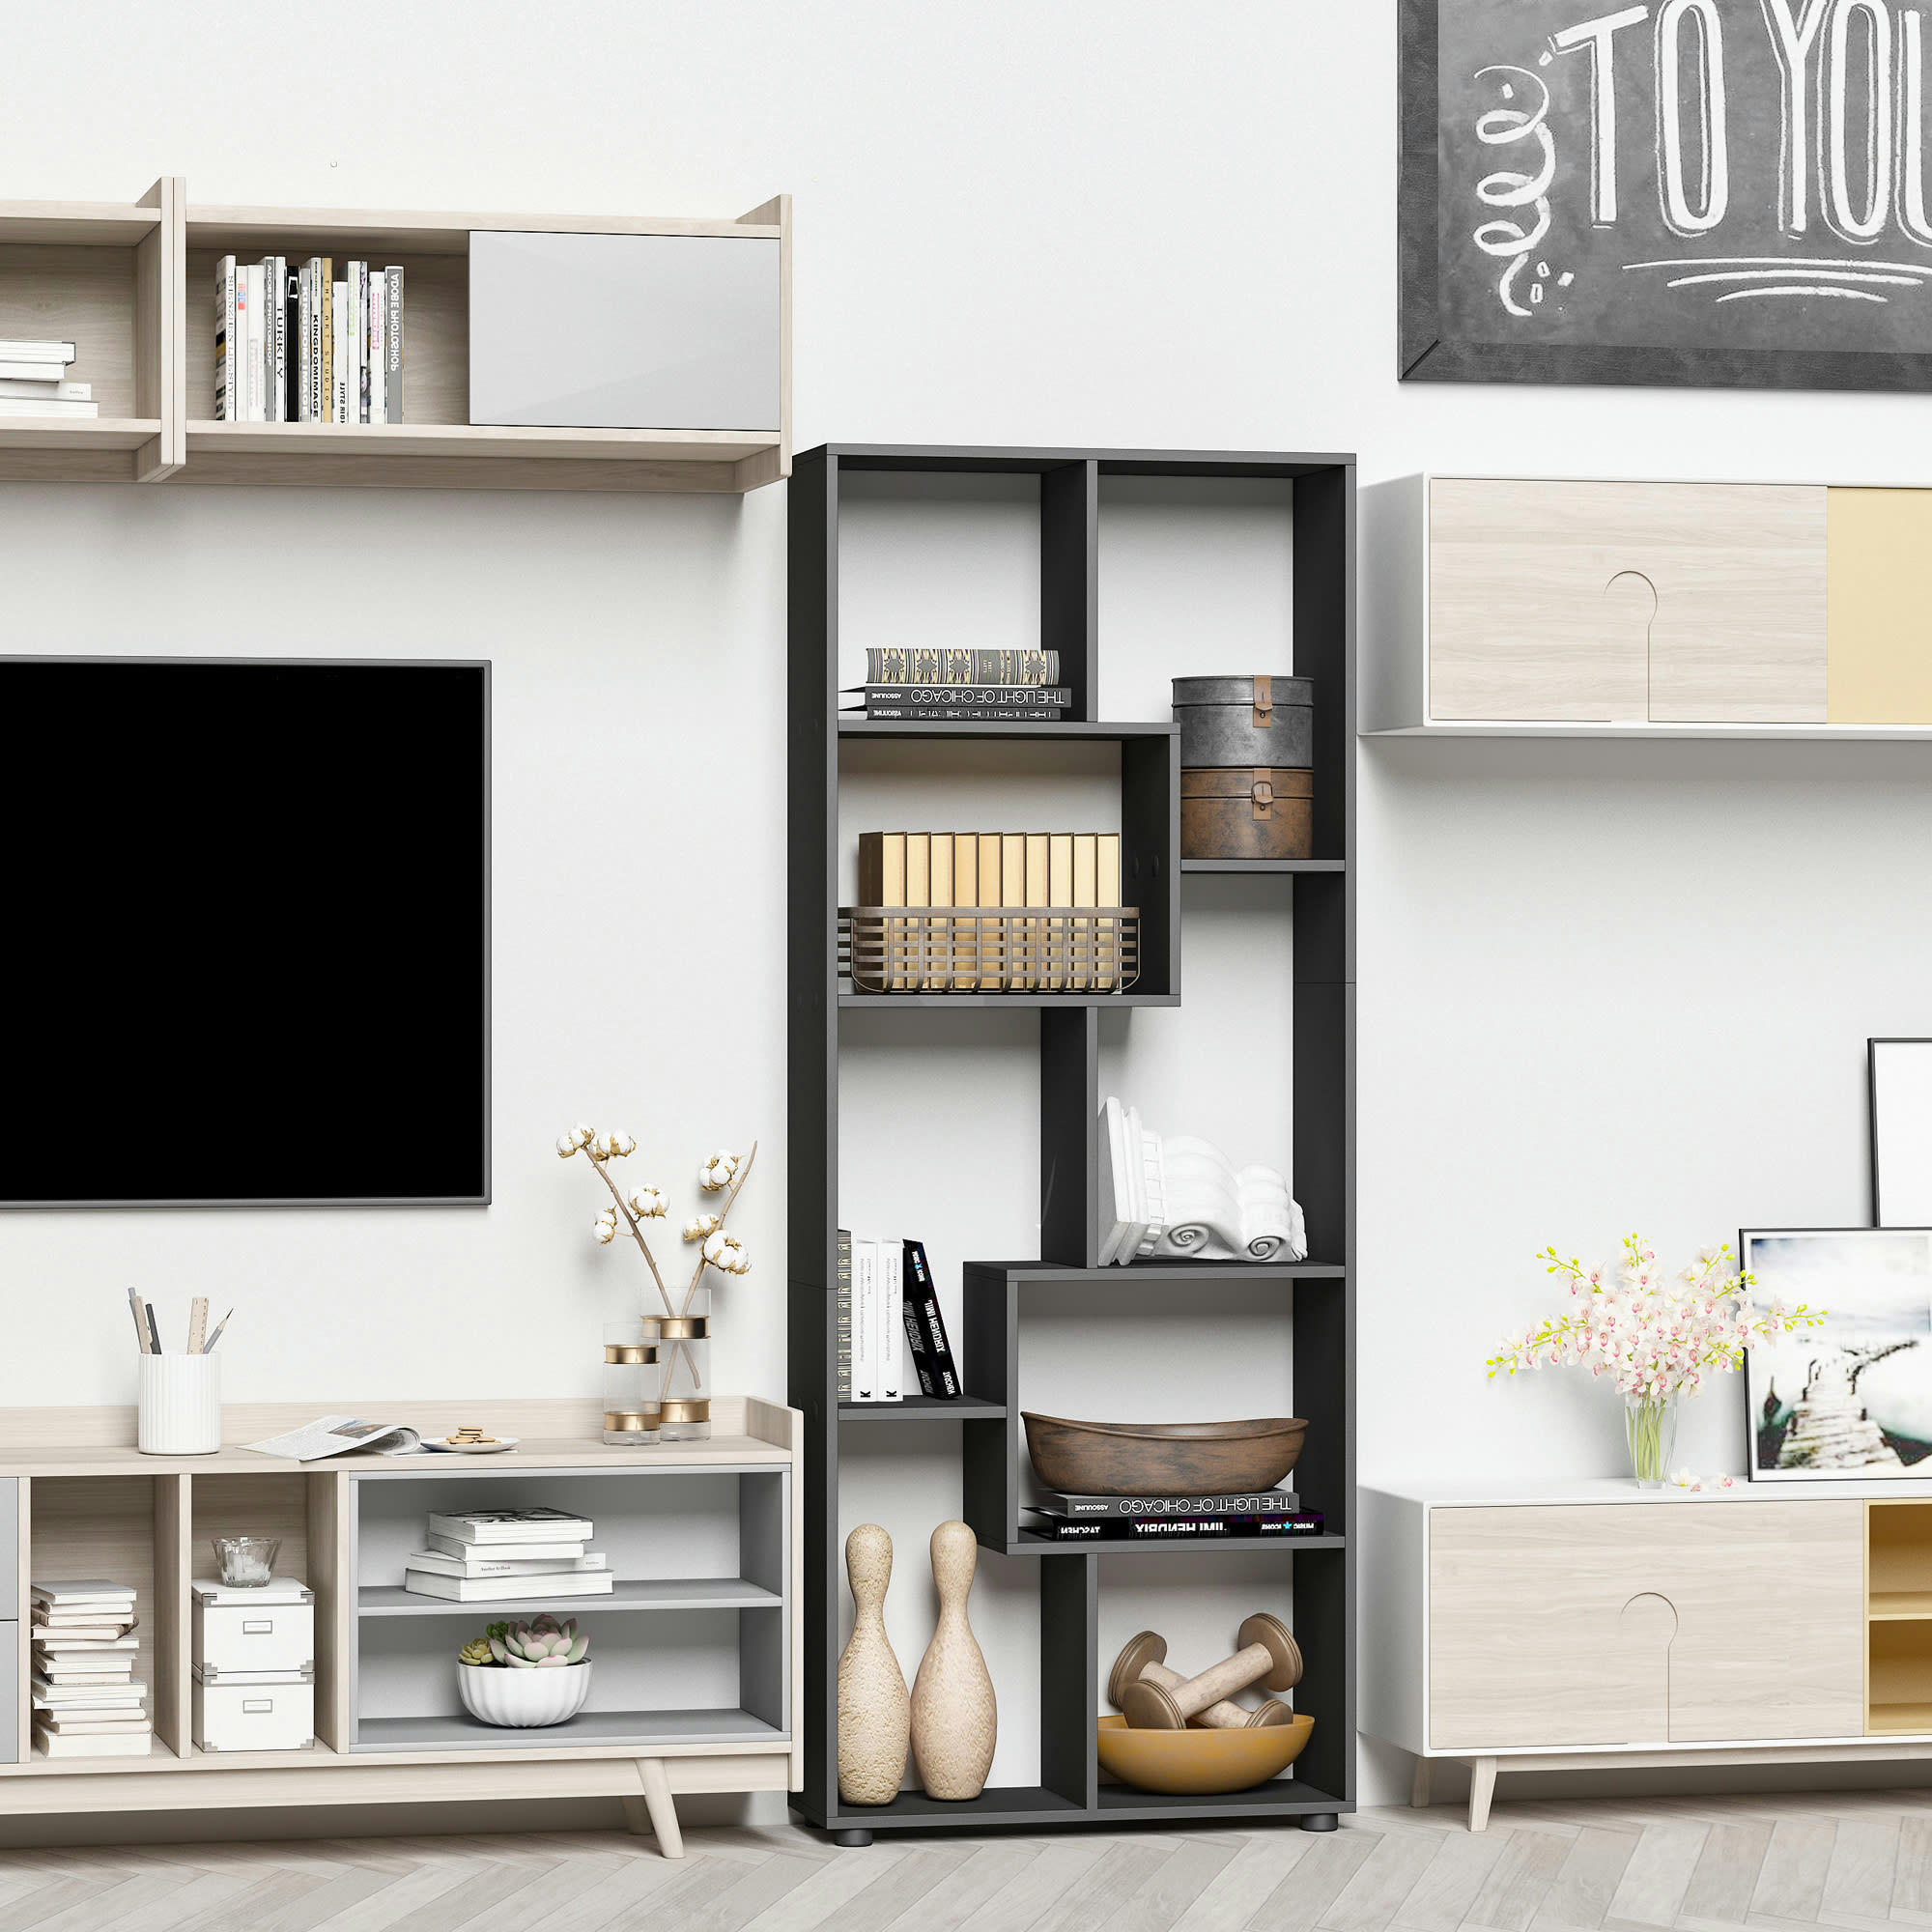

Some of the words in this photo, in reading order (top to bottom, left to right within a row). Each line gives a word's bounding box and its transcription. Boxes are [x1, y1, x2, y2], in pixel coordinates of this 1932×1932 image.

[1550, 0, 1728, 238] TO
[911, 689, 975, 703] CHICAGO
[977, 690, 996, 703] OF
[997, 690, 1036, 703] LIGHT
[1037, 690, 1065, 704] THE
[1119, 1499, 1190, 1514] CHICAGO
[1192, 1498, 1214, 1512] OF
[1216, 1497, 1260, 1511] LIGHT
[1262, 1496, 1292, 1510] THE
